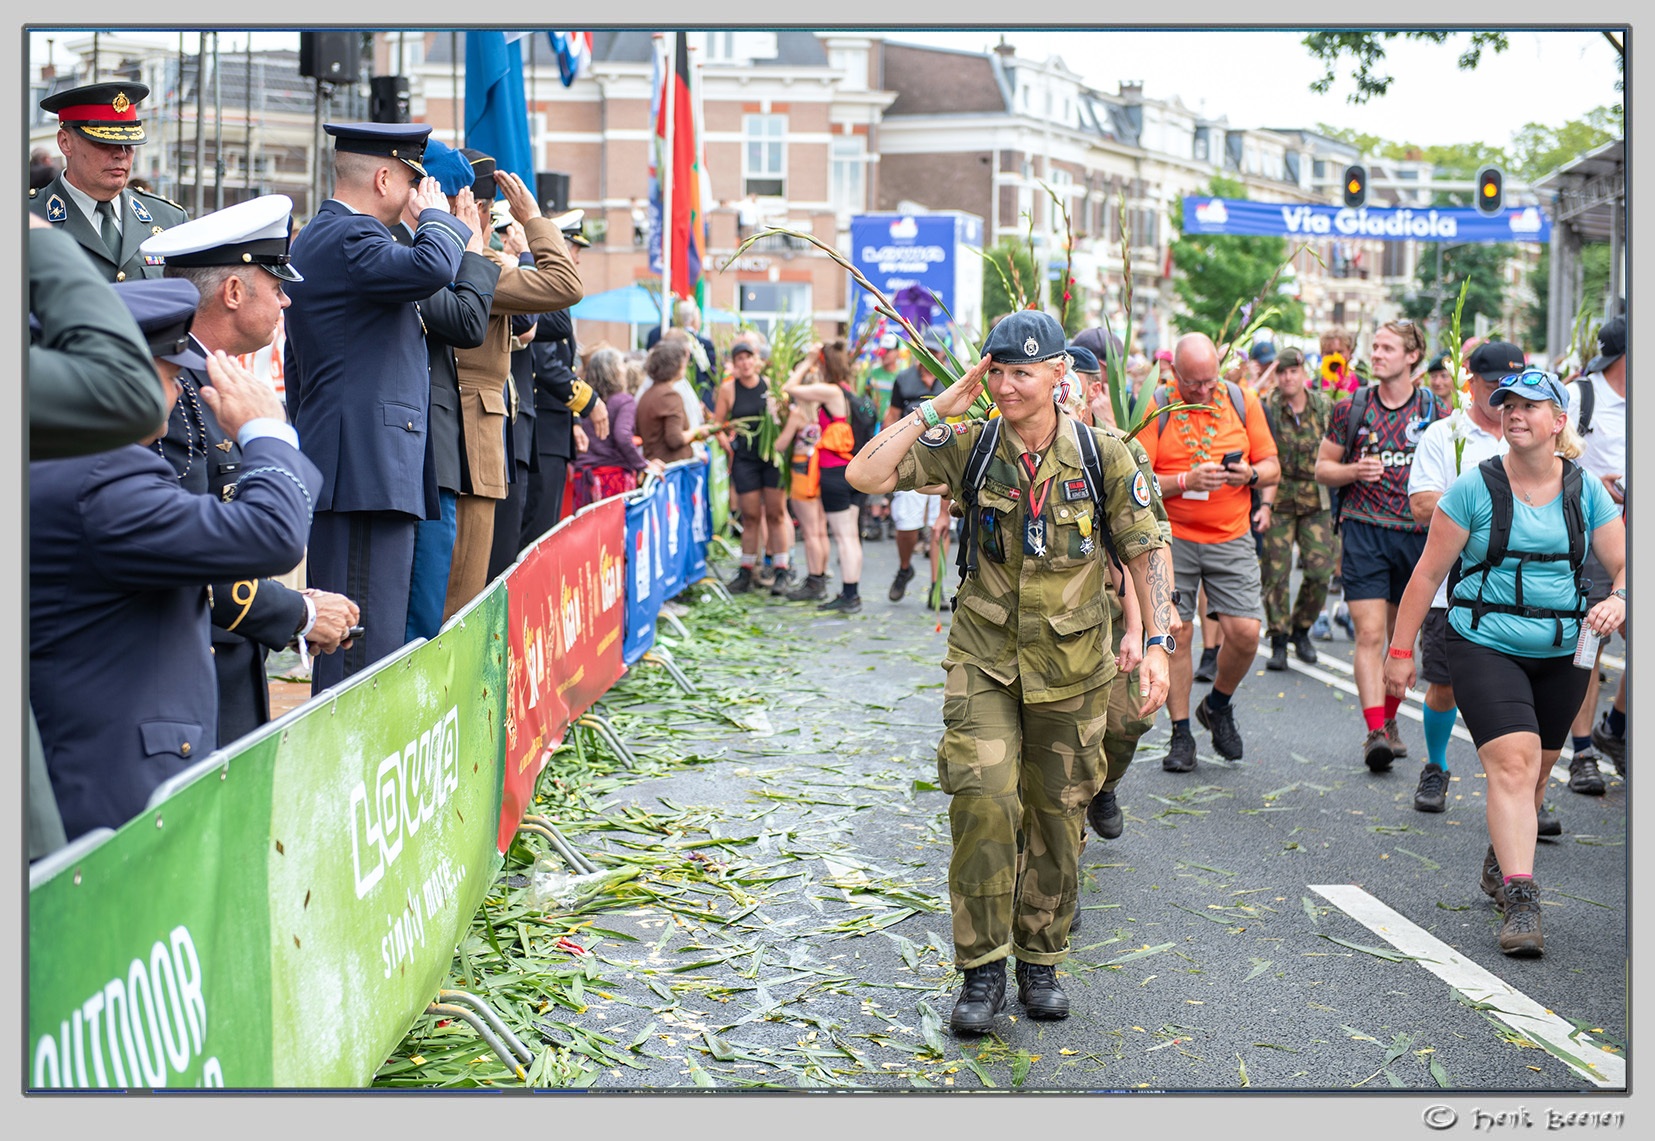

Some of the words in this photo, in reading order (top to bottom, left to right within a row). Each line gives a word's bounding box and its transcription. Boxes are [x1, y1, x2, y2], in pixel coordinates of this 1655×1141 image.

[1281, 206, 1331, 233] Via
[1335, 207, 1457, 237] Gladiola
[350, 704, 459, 900] LOWA
